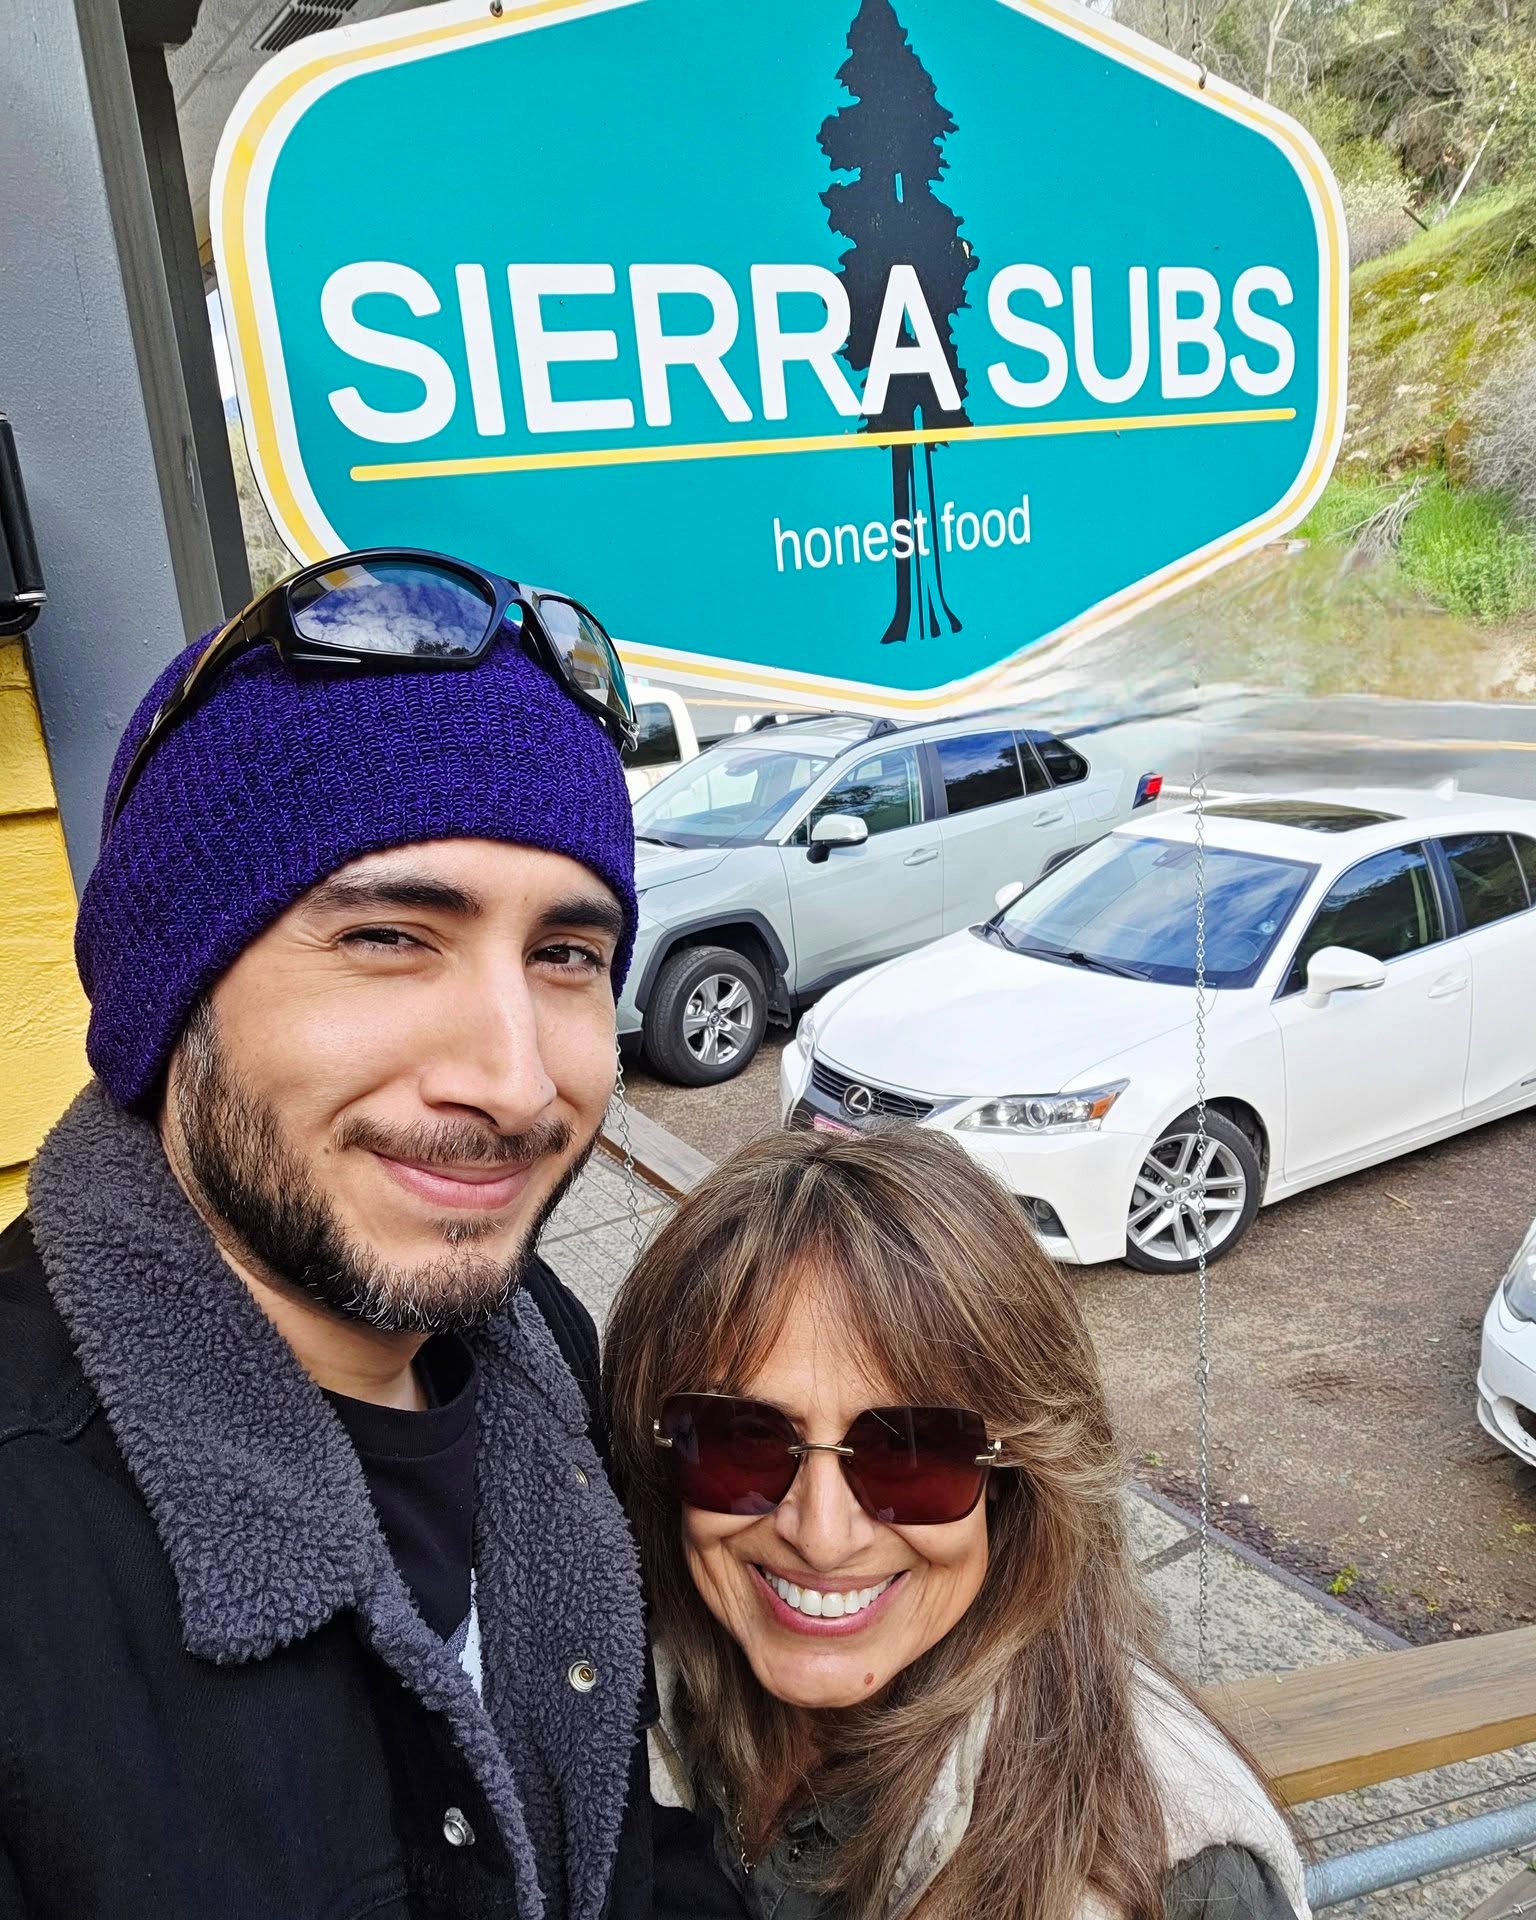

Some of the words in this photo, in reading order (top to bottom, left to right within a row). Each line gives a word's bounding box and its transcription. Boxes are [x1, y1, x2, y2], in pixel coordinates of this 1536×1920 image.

[320, 262, 962, 444] SIERRA
[987, 264, 1296, 408] SUBS
[773, 509, 930, 572] honest
[941, 494, 1031, 552] food
